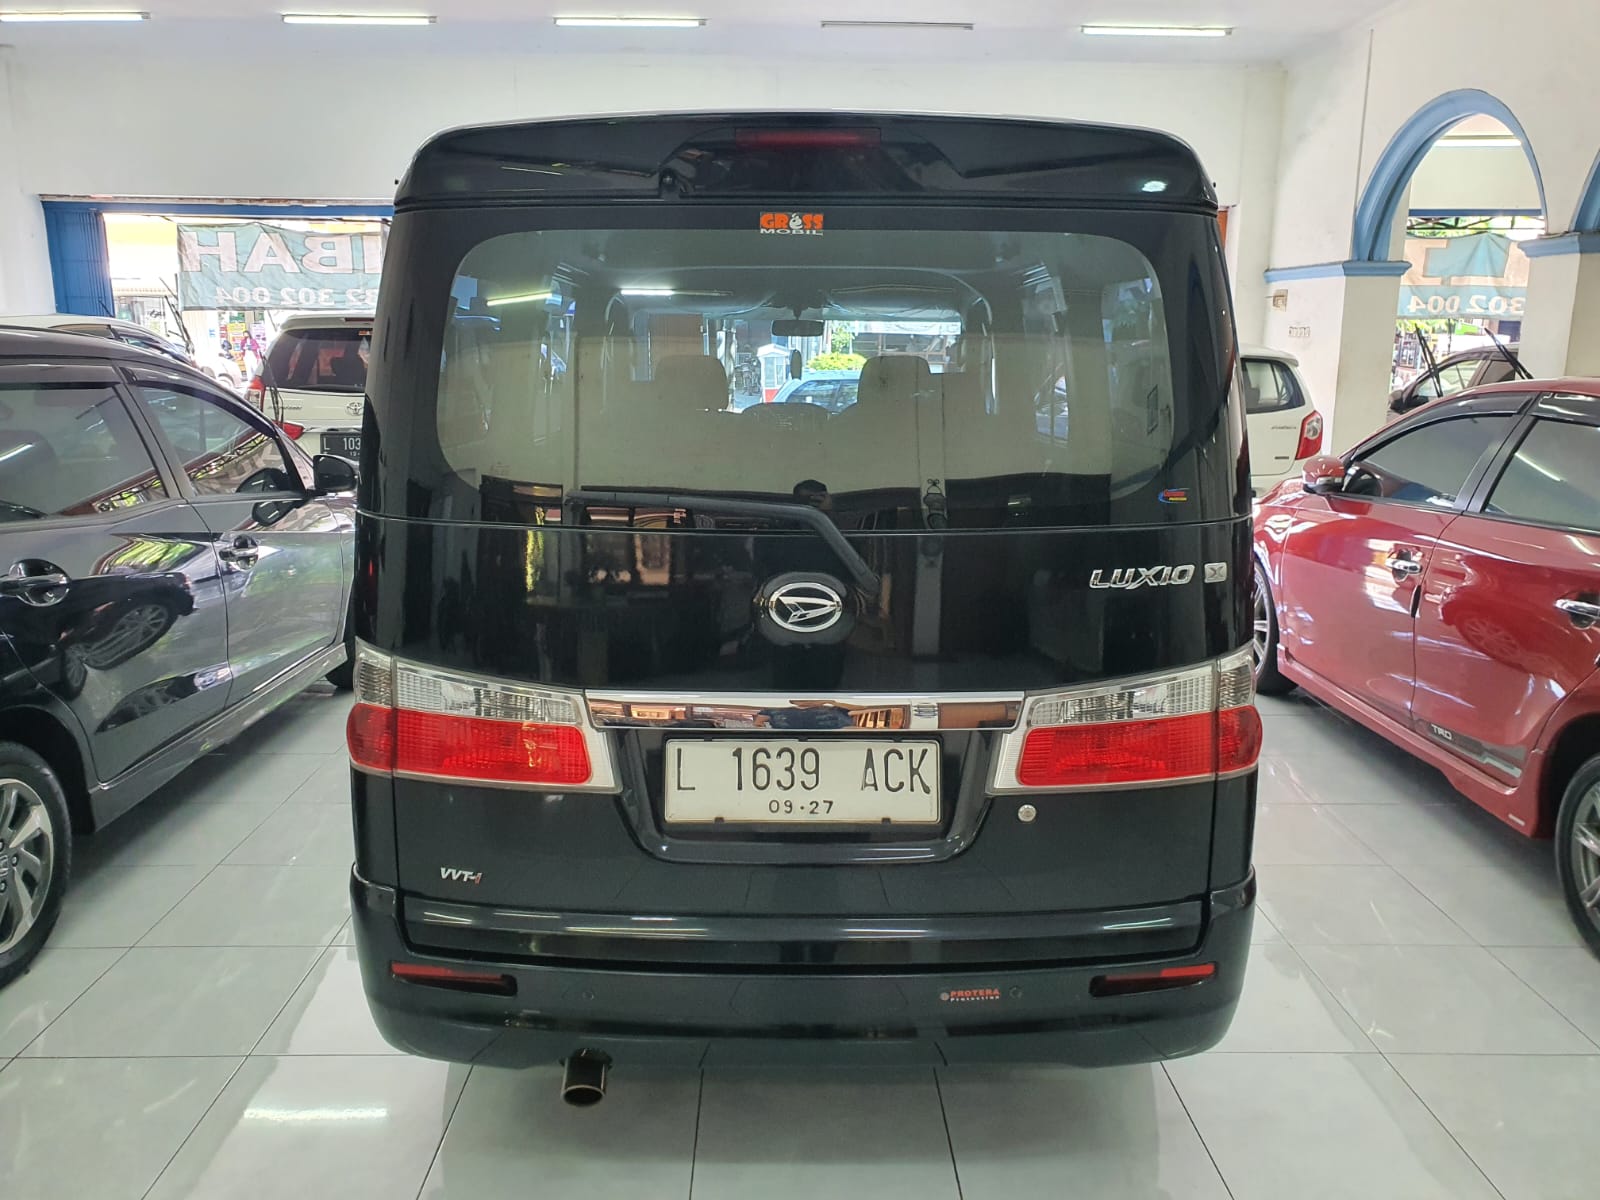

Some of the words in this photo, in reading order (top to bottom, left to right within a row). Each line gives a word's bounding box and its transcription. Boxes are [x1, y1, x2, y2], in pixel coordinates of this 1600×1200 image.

[760, 228, 824, 236] MOBIL
[323, 437, 331, 450] L
[1089, 564, 1195, 589] LUXIO
[1431, 724, 1452, 740] TRD
[676, 748, 696, 790] L
[732, 747, 820, 791] 1639
[861, 748, 931, 795] ACK
[950, 988, 1000, 997] PROTERA
